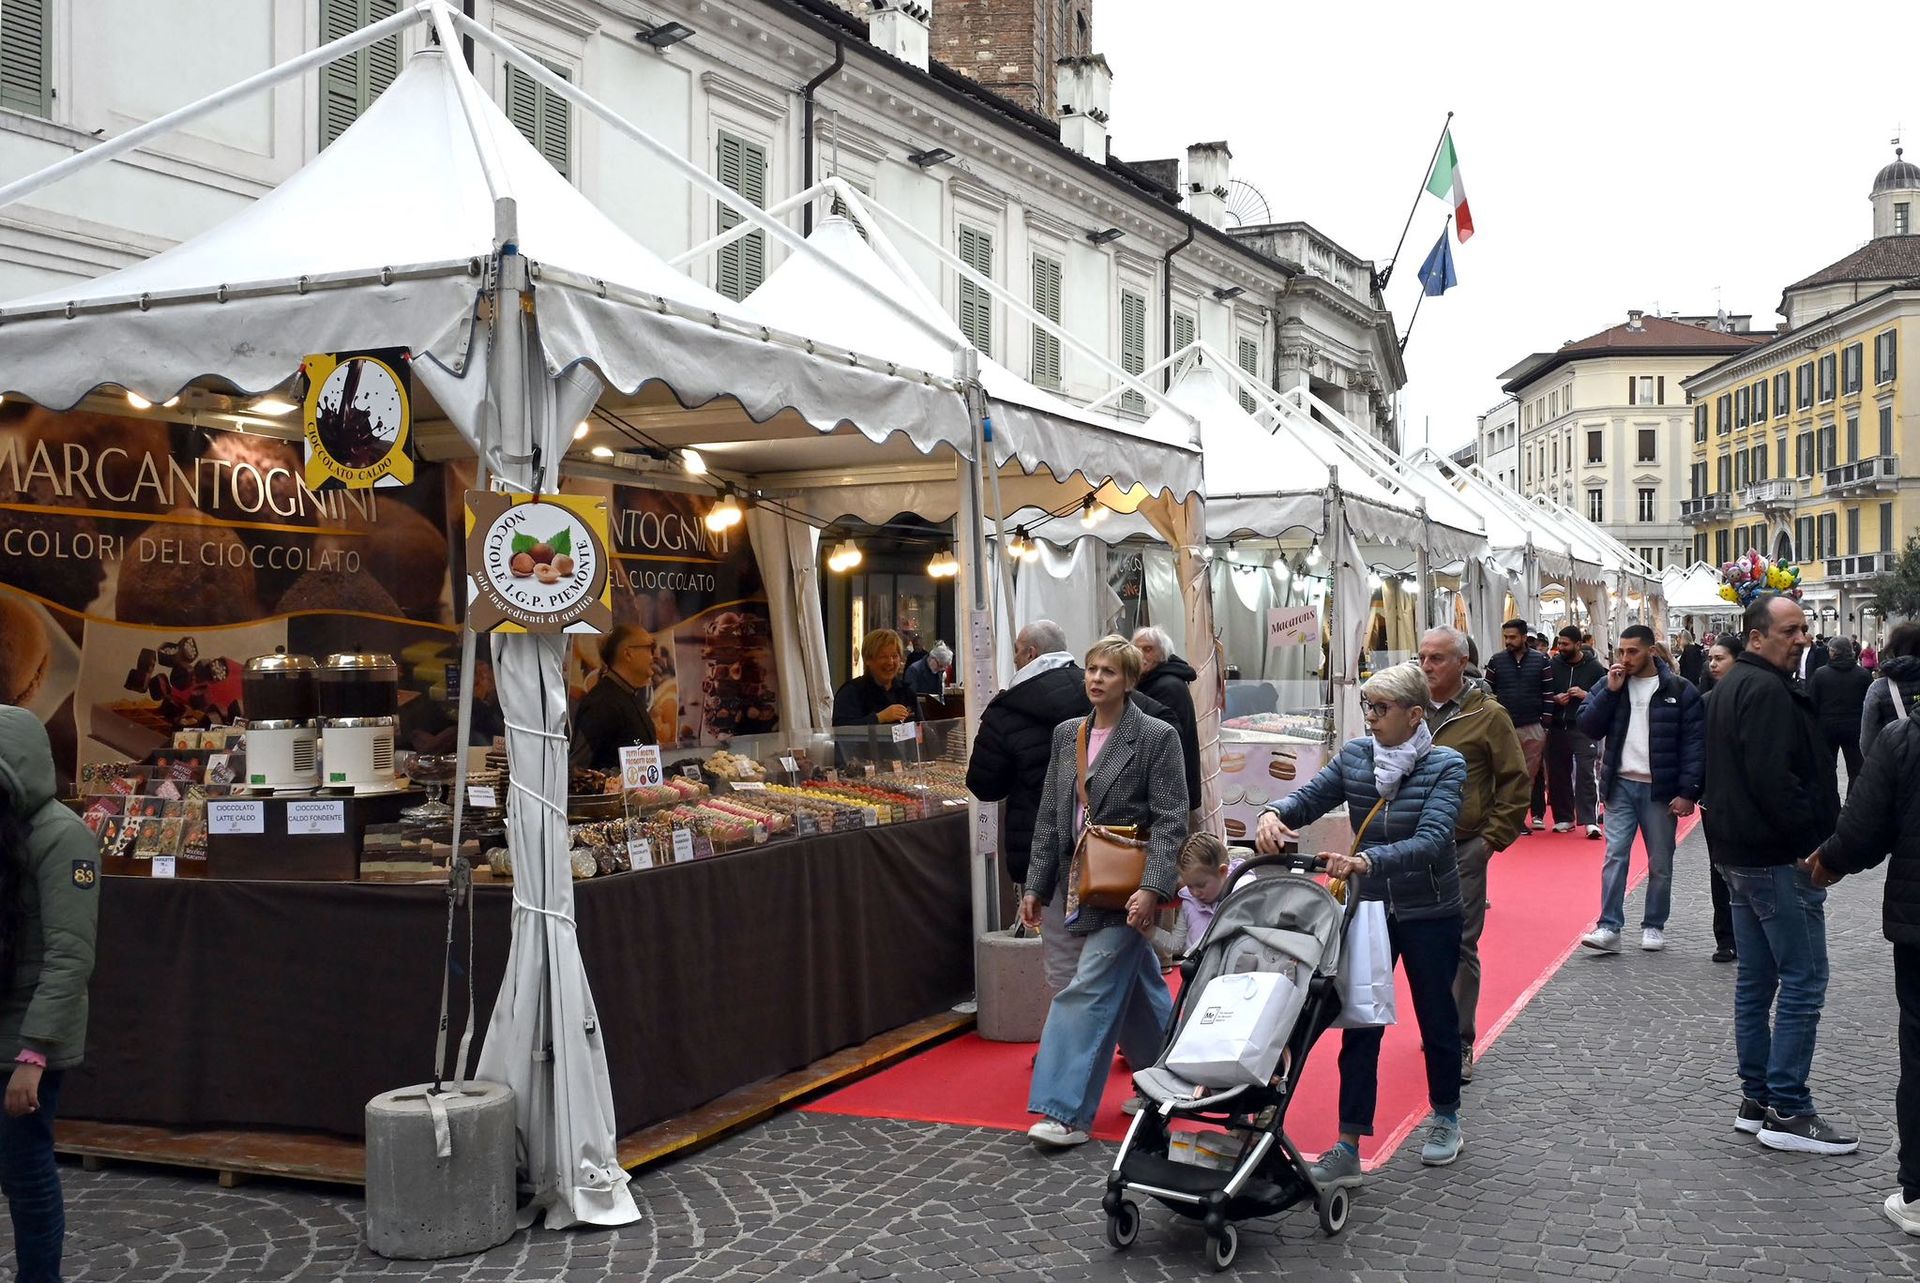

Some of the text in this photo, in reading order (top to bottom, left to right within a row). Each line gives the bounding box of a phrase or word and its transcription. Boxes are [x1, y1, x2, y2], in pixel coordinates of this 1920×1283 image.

[307, 421, 392, 480] CIOCCOLATO CALDO
[4, 528, 360, 573] COLORI DEL CIOCCOLATO
[489, 510, 591, 608] NOCCIOLE I.G.P. PIEMONTE
[629, 570, 715, 592] CIOCCOLATO
[475, 570, 594, 624] solo ingredienti di qualità
[1271, 610, 1315, 635] Macarons
[216, 804, 255, 812] CIOCCOLATO
[235, 814, 256, 822] CALDO
[295, 804, 335, 812] CIOCCOLATO
[309, 814, 342, 822] FONDENTE
